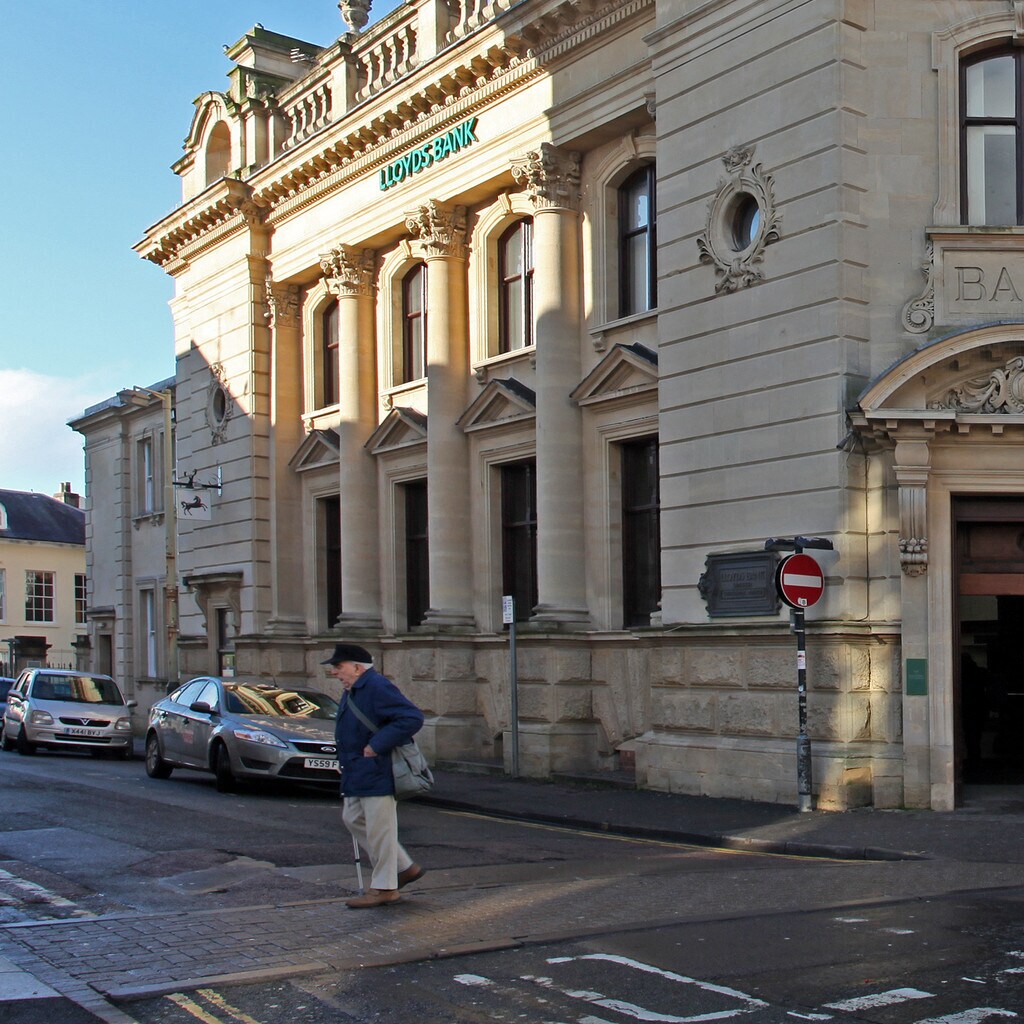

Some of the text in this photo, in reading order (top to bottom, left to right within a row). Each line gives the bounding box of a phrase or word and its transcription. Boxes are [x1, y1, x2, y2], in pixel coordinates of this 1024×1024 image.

[379, 117, 478, 190] LLOYDS BANK
[308, 759, 330, 768] YS59
